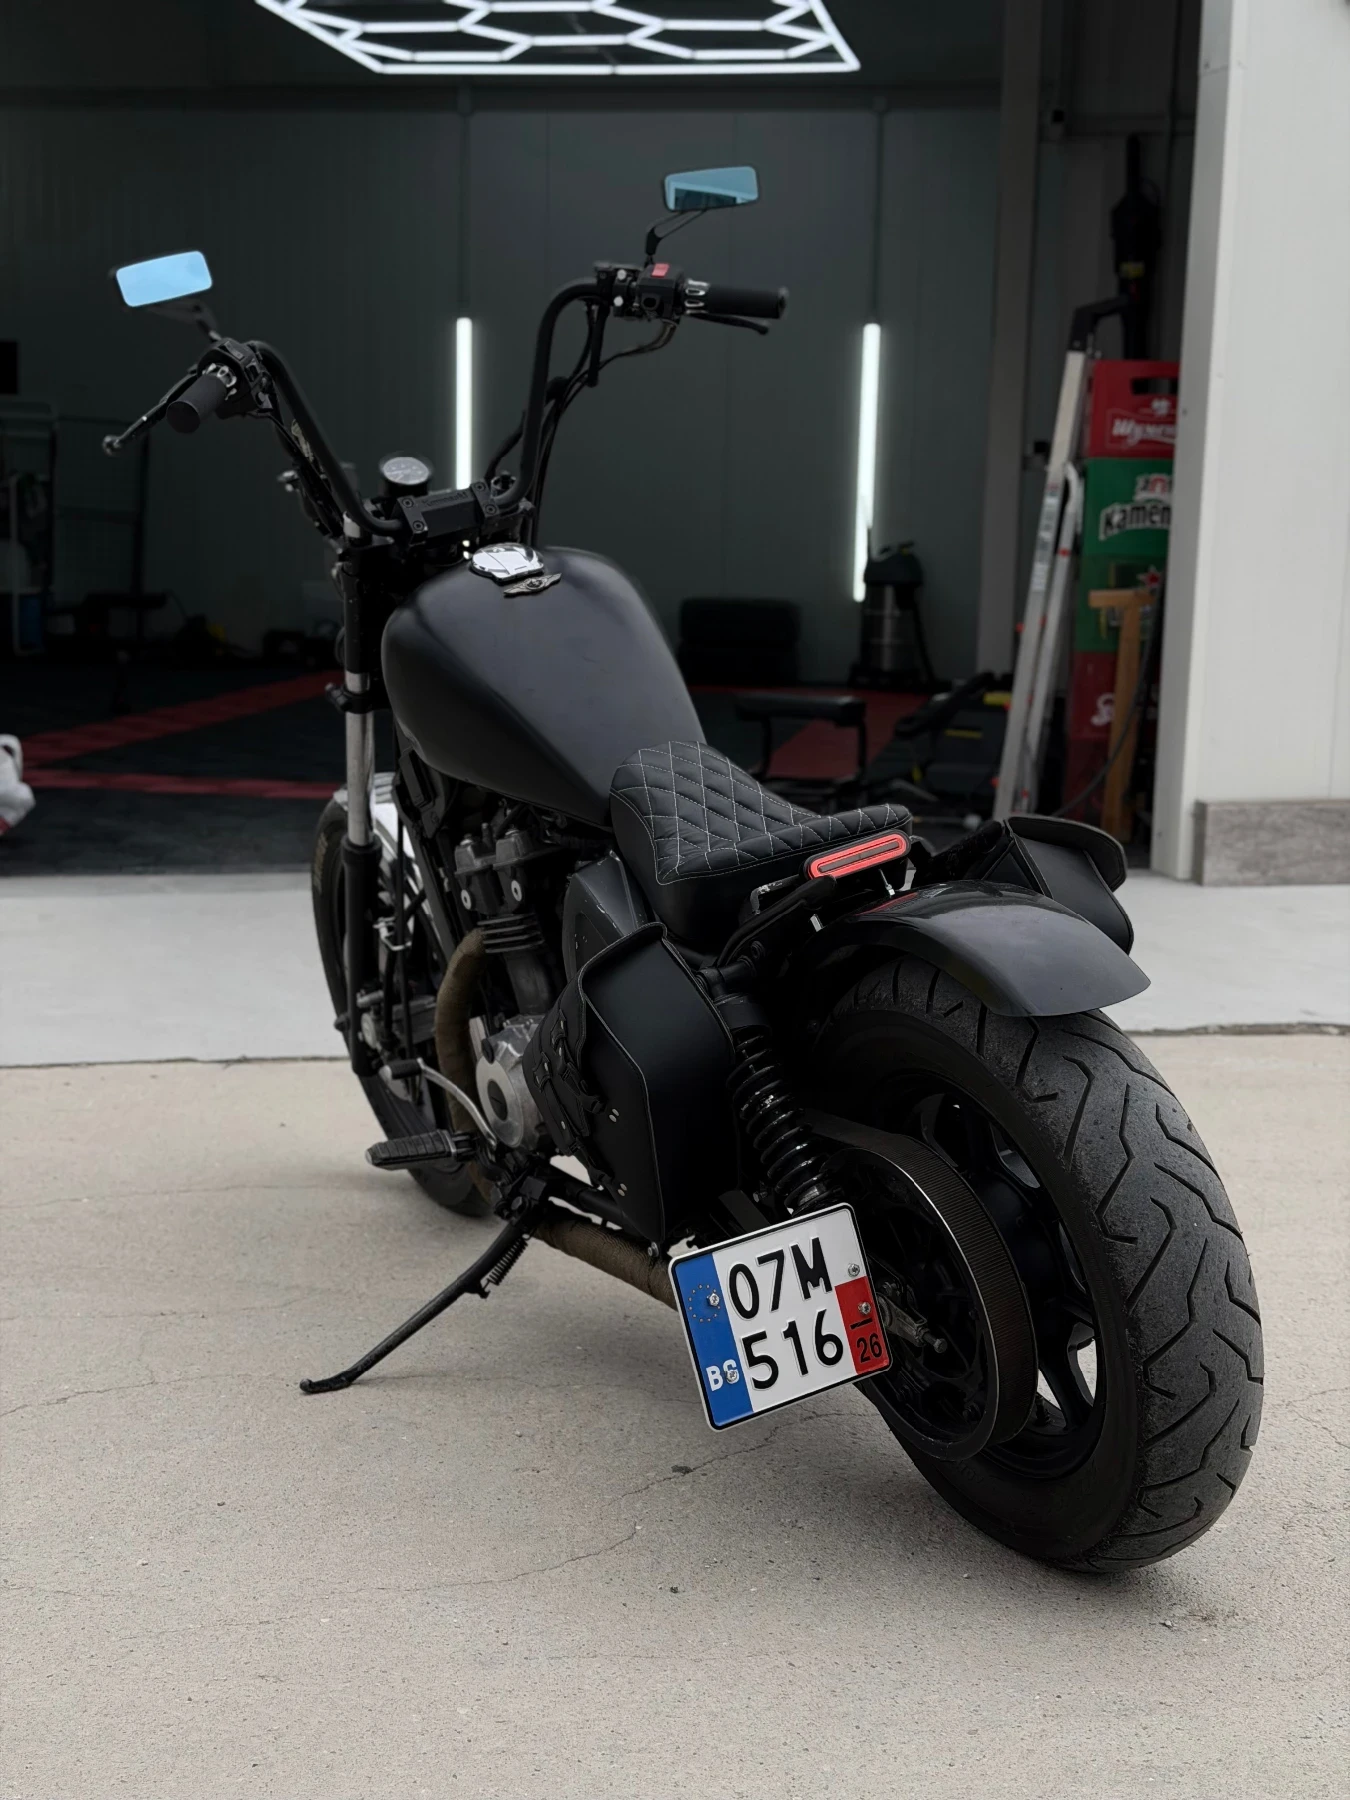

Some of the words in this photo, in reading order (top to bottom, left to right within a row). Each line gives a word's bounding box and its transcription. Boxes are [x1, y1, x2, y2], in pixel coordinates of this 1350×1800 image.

[728, 1237, 833, 1320] 07M
[741, 1308, 844, 1390] 516
[856, 1333, 883, 1364] 26
